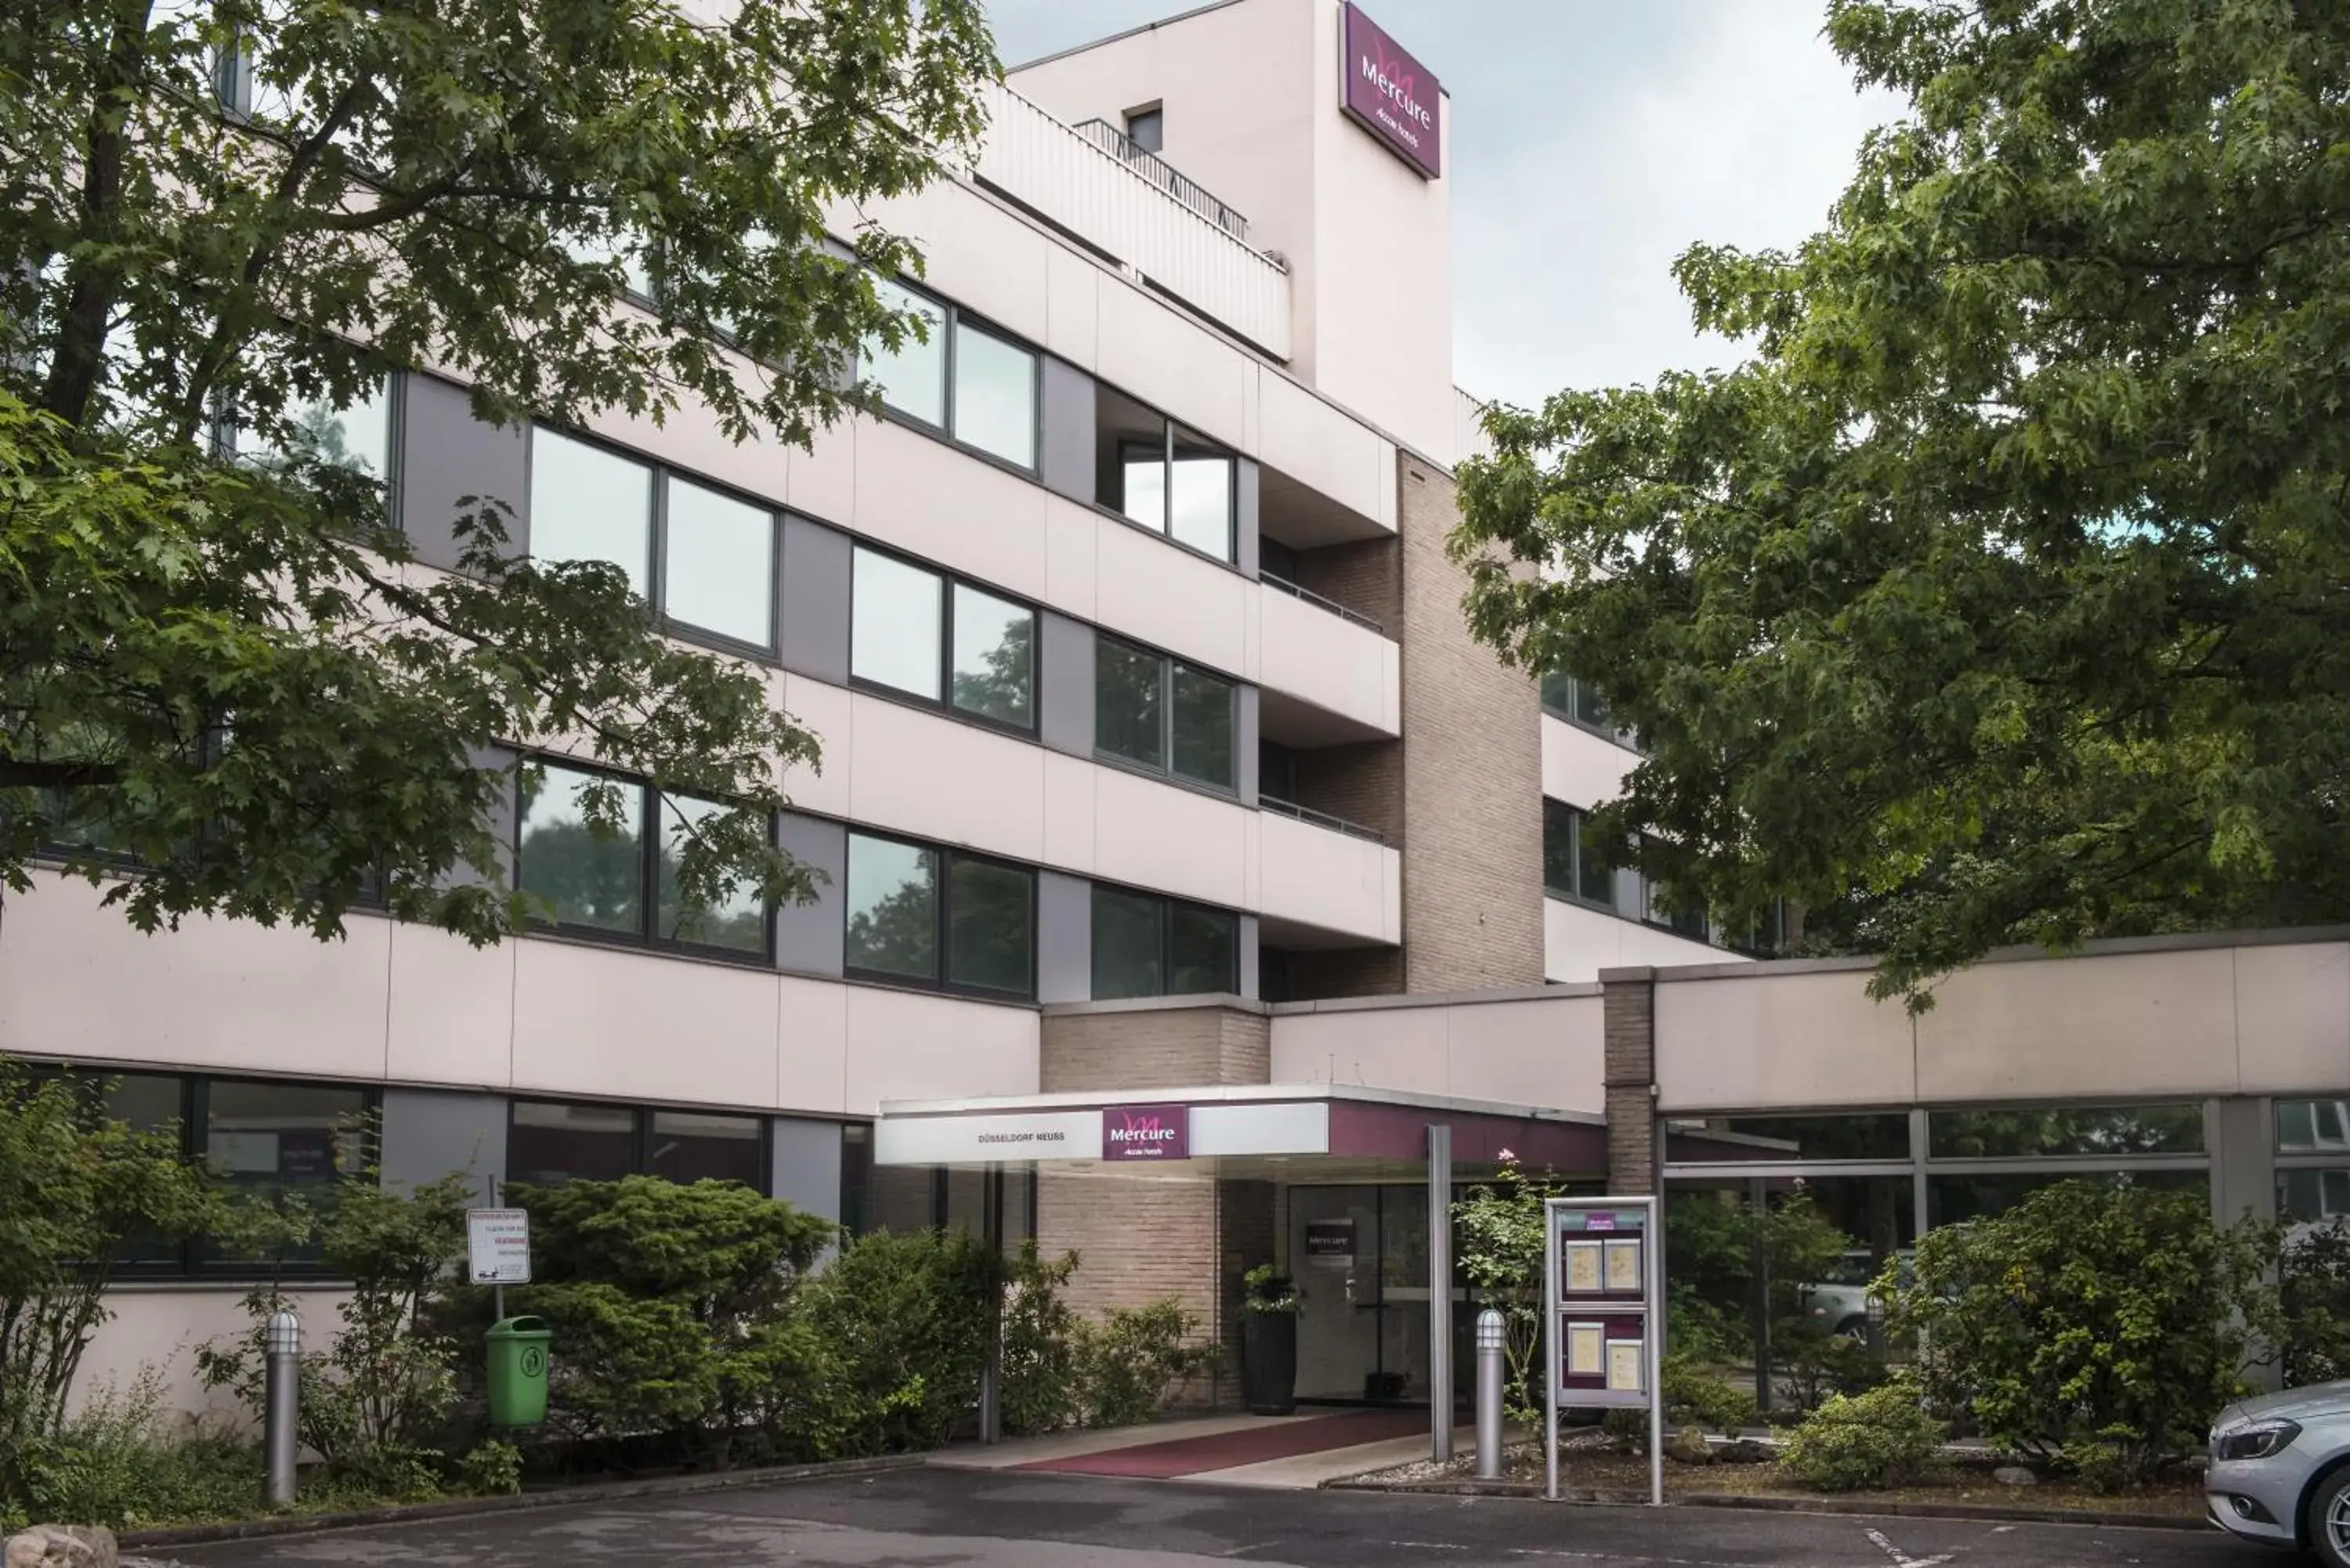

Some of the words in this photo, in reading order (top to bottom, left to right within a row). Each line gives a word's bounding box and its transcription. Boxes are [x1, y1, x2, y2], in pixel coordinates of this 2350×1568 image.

[1361, 55, 1430, 130] Mercure
[978, 1133, 1034, 1143] DÜSSELDORF
[1036, 1132, 1065, 1141] NEUSS
[1111, 1129, 1175, 1141] Mercure
